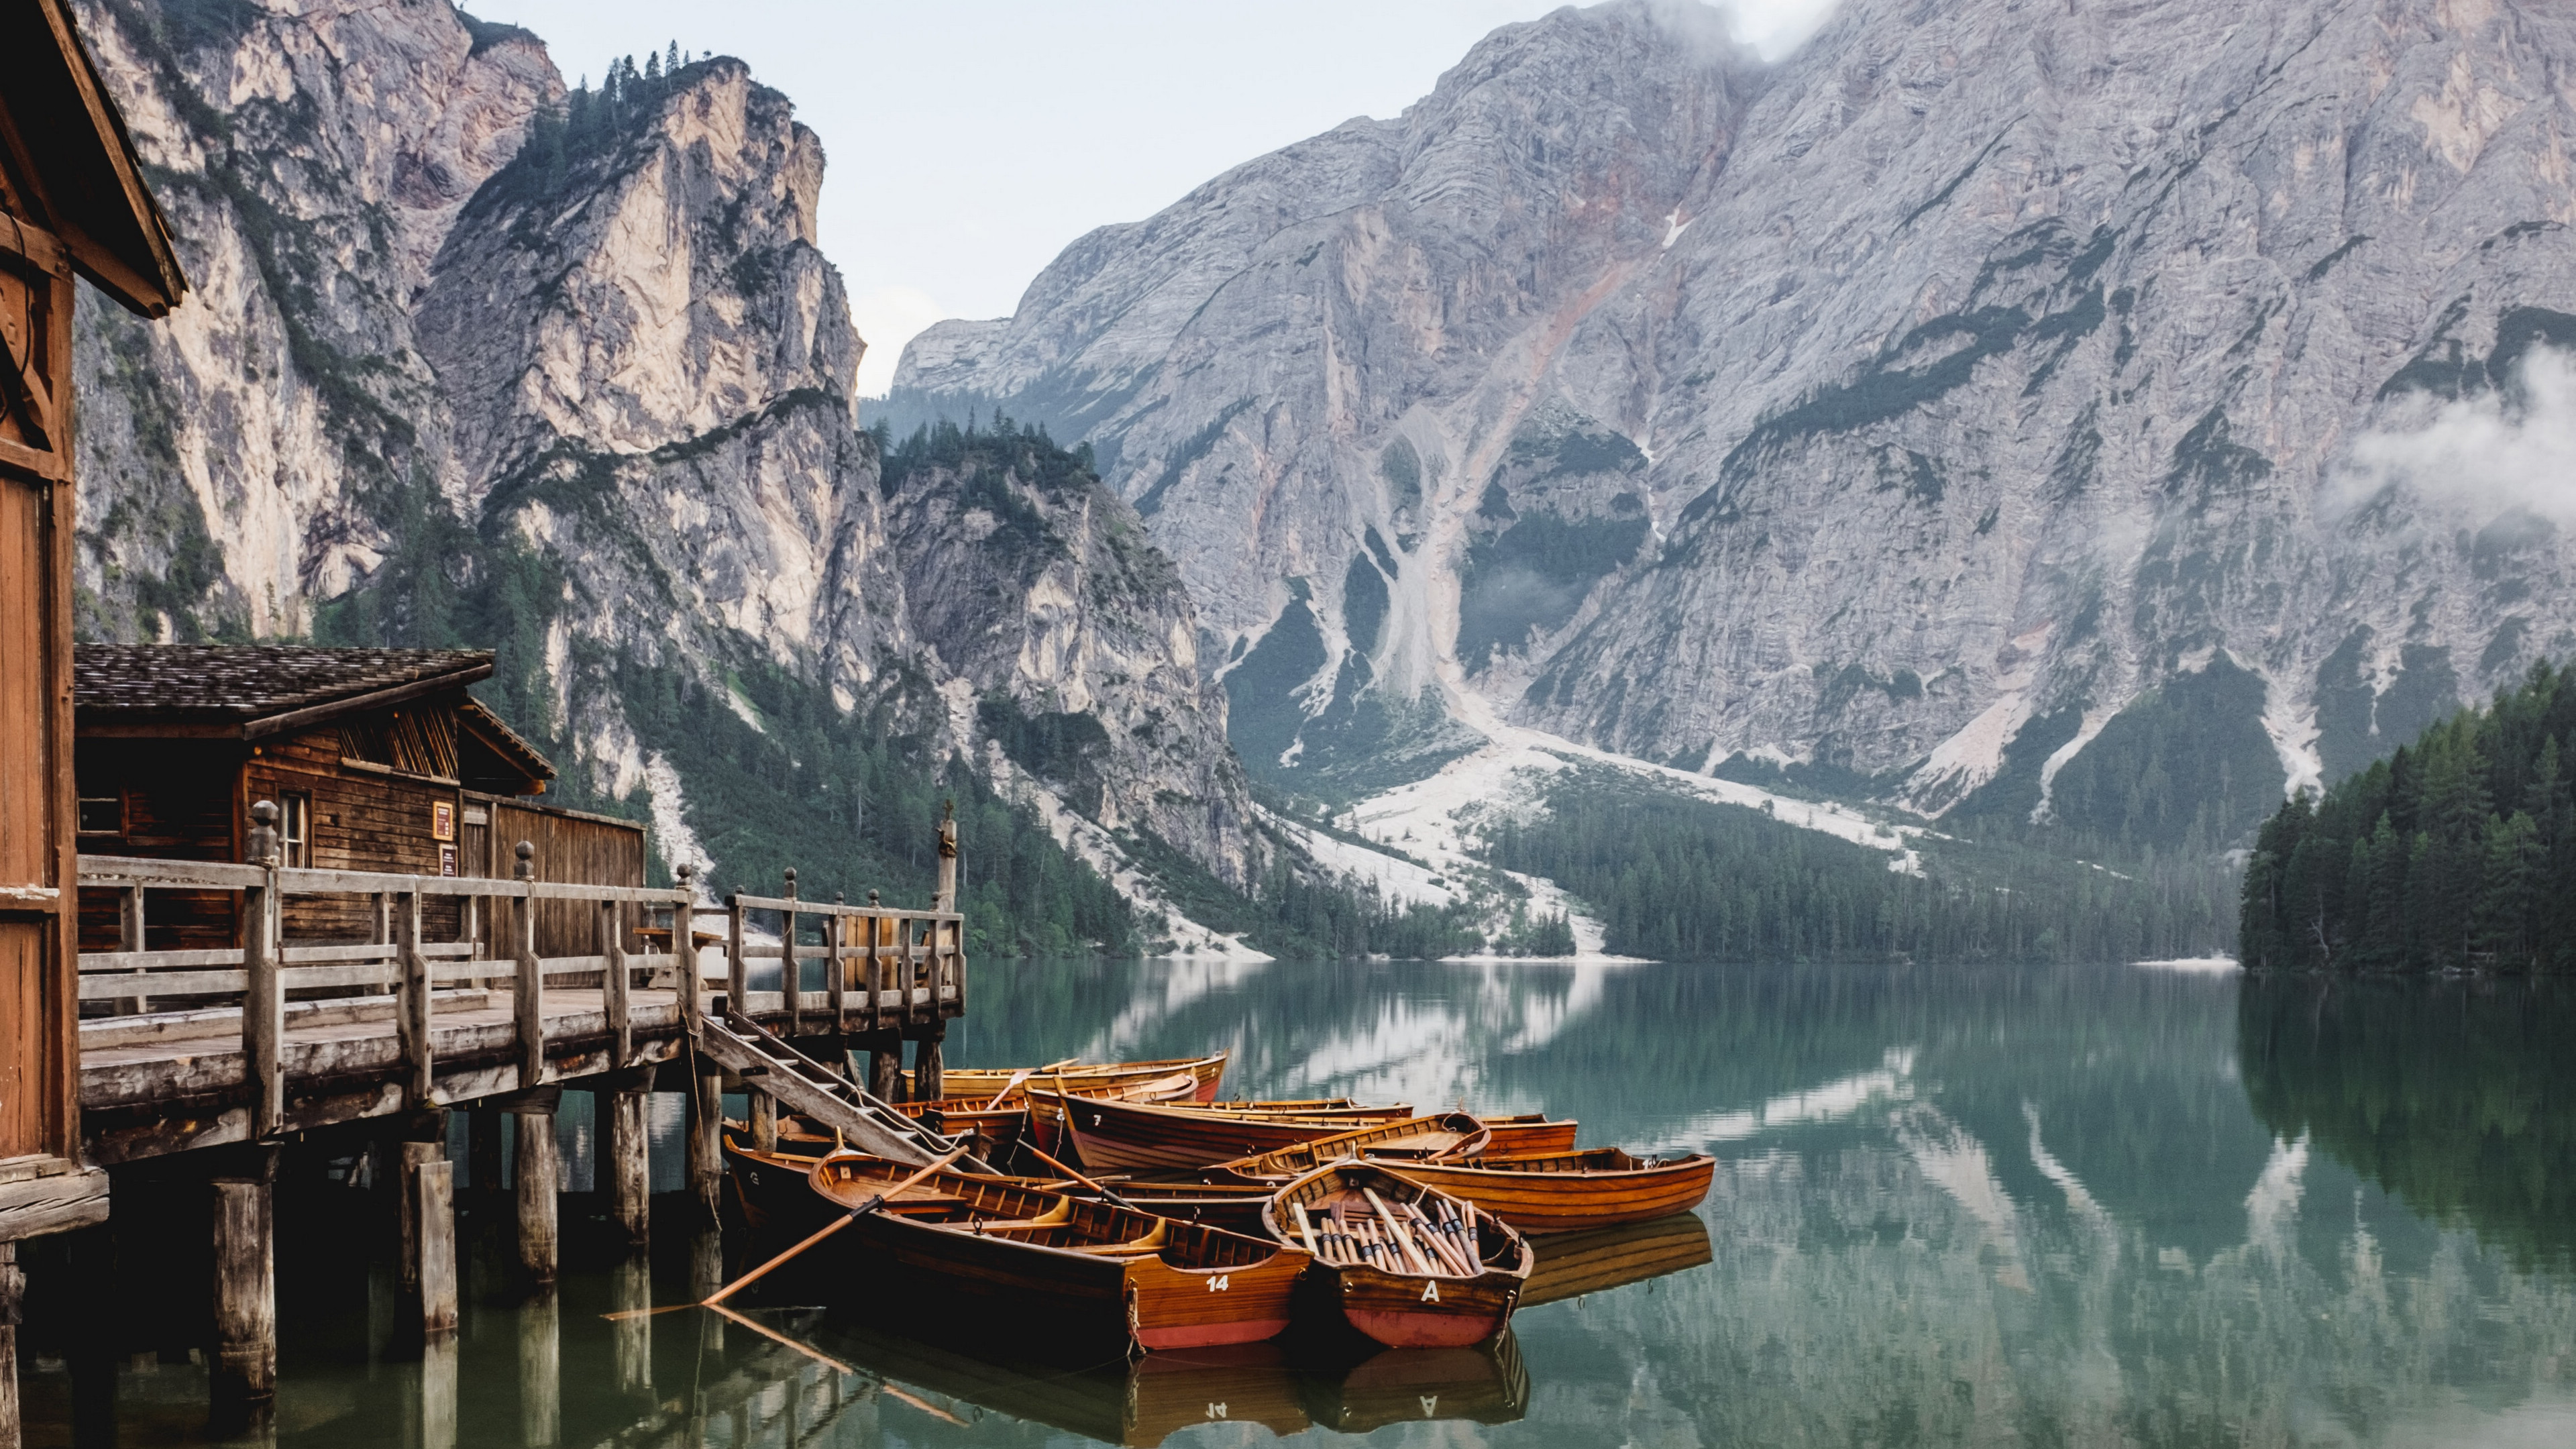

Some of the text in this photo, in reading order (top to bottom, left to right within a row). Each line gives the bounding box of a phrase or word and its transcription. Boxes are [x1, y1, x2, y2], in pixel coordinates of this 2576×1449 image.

[1093, 1114, 1102, 1126] 7
[1206, 1275, 1229, 1292] 14
[1421, 1280, 1440, 1302] A
